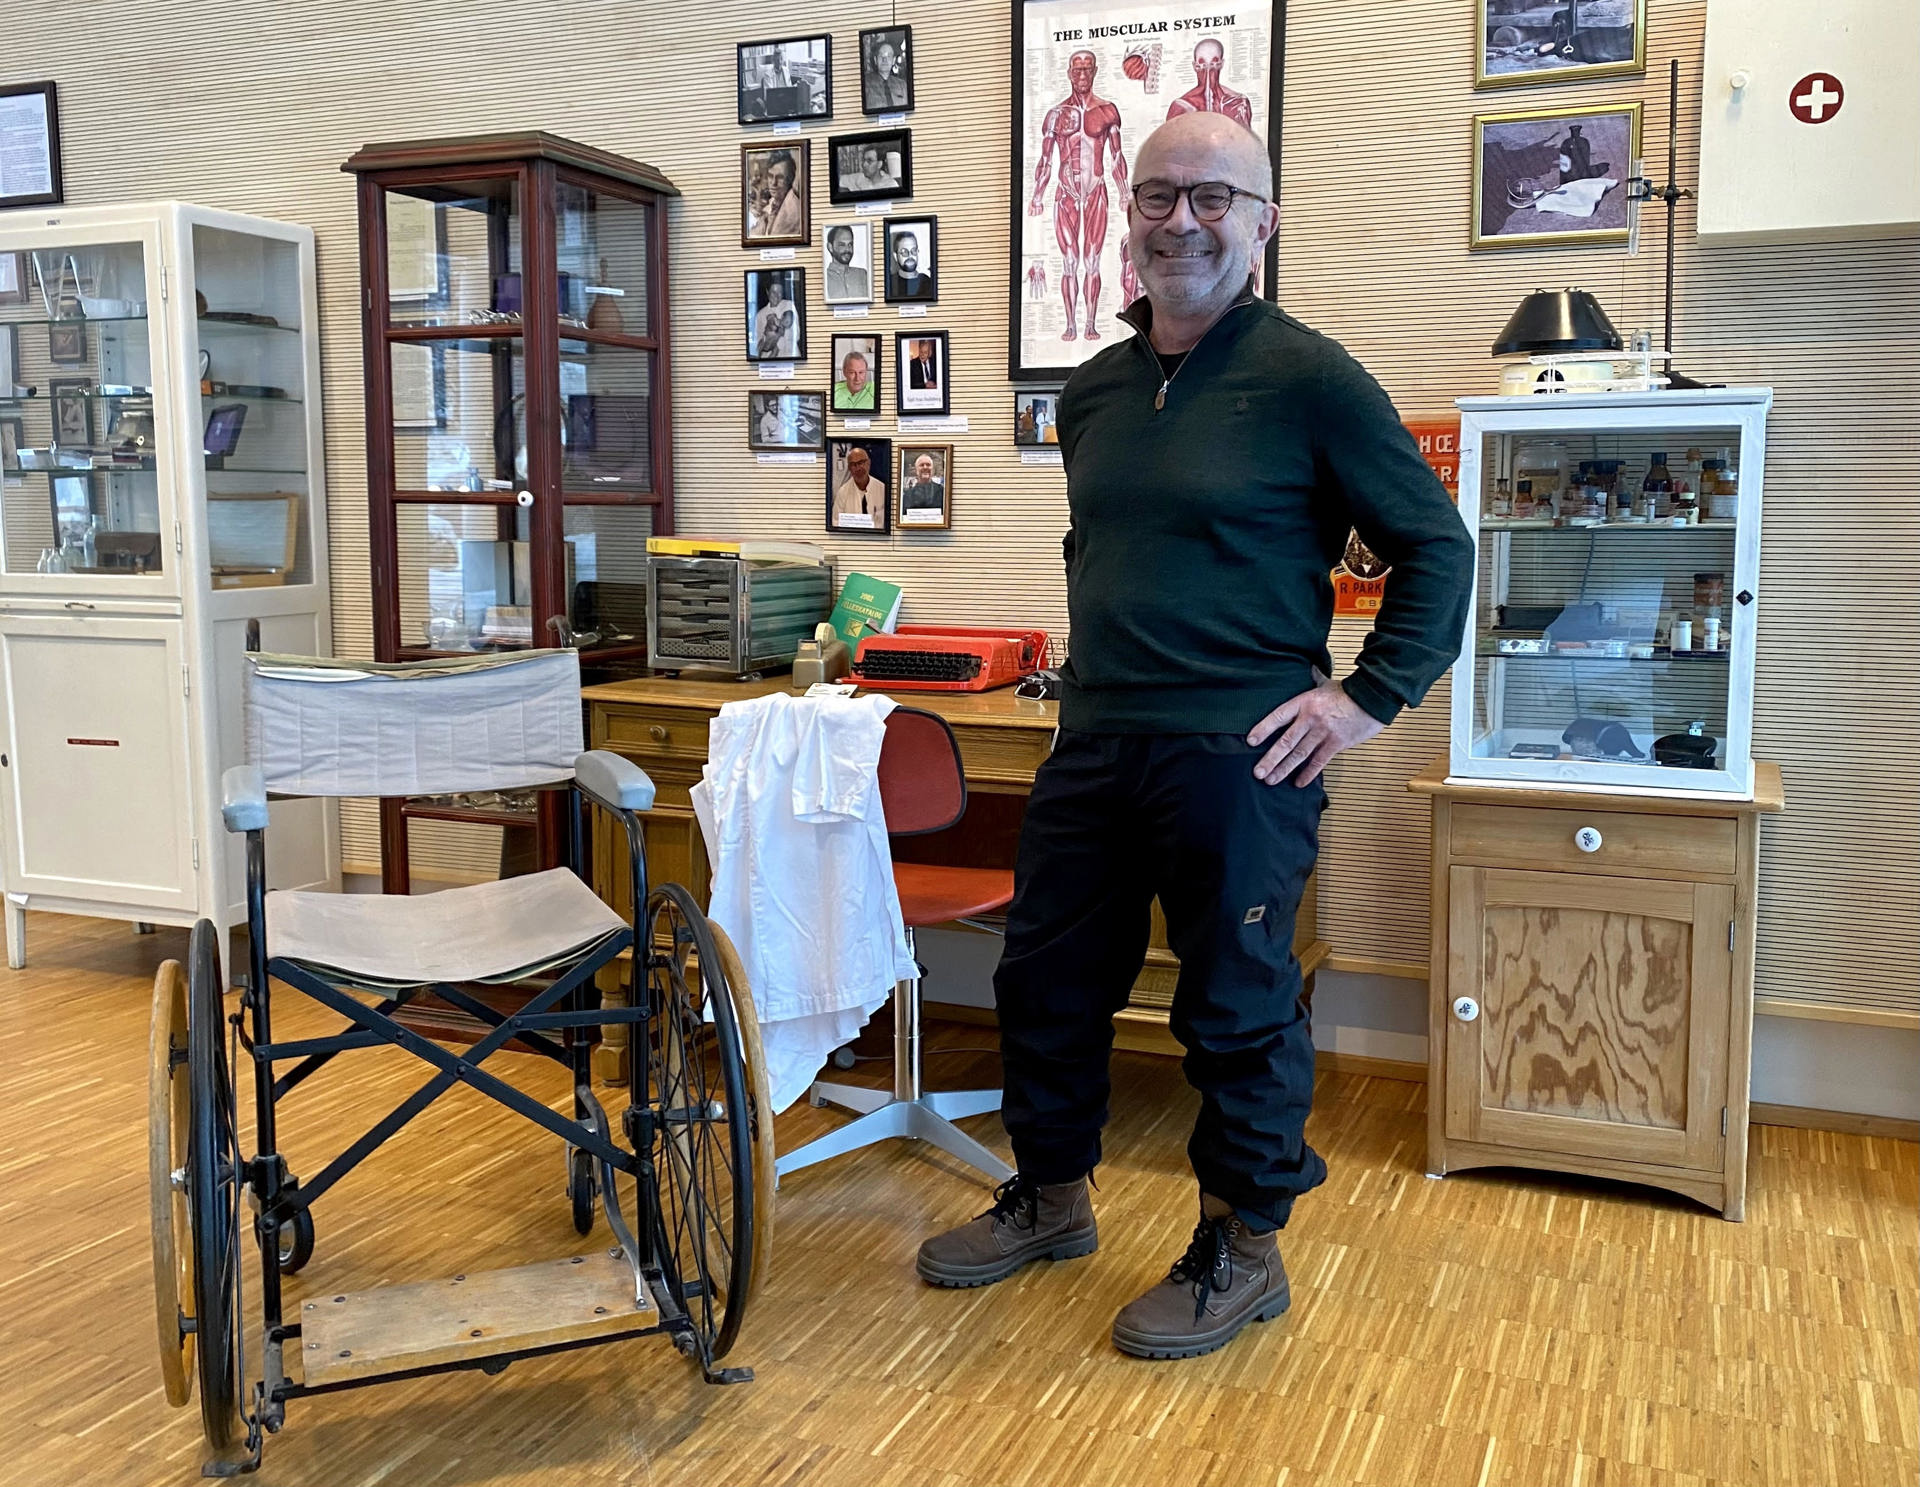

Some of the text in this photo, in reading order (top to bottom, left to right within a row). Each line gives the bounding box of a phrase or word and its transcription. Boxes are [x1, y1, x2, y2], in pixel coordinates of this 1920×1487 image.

[1053, 14, 1236, 43] THE MUSCULAR SYSTEM
